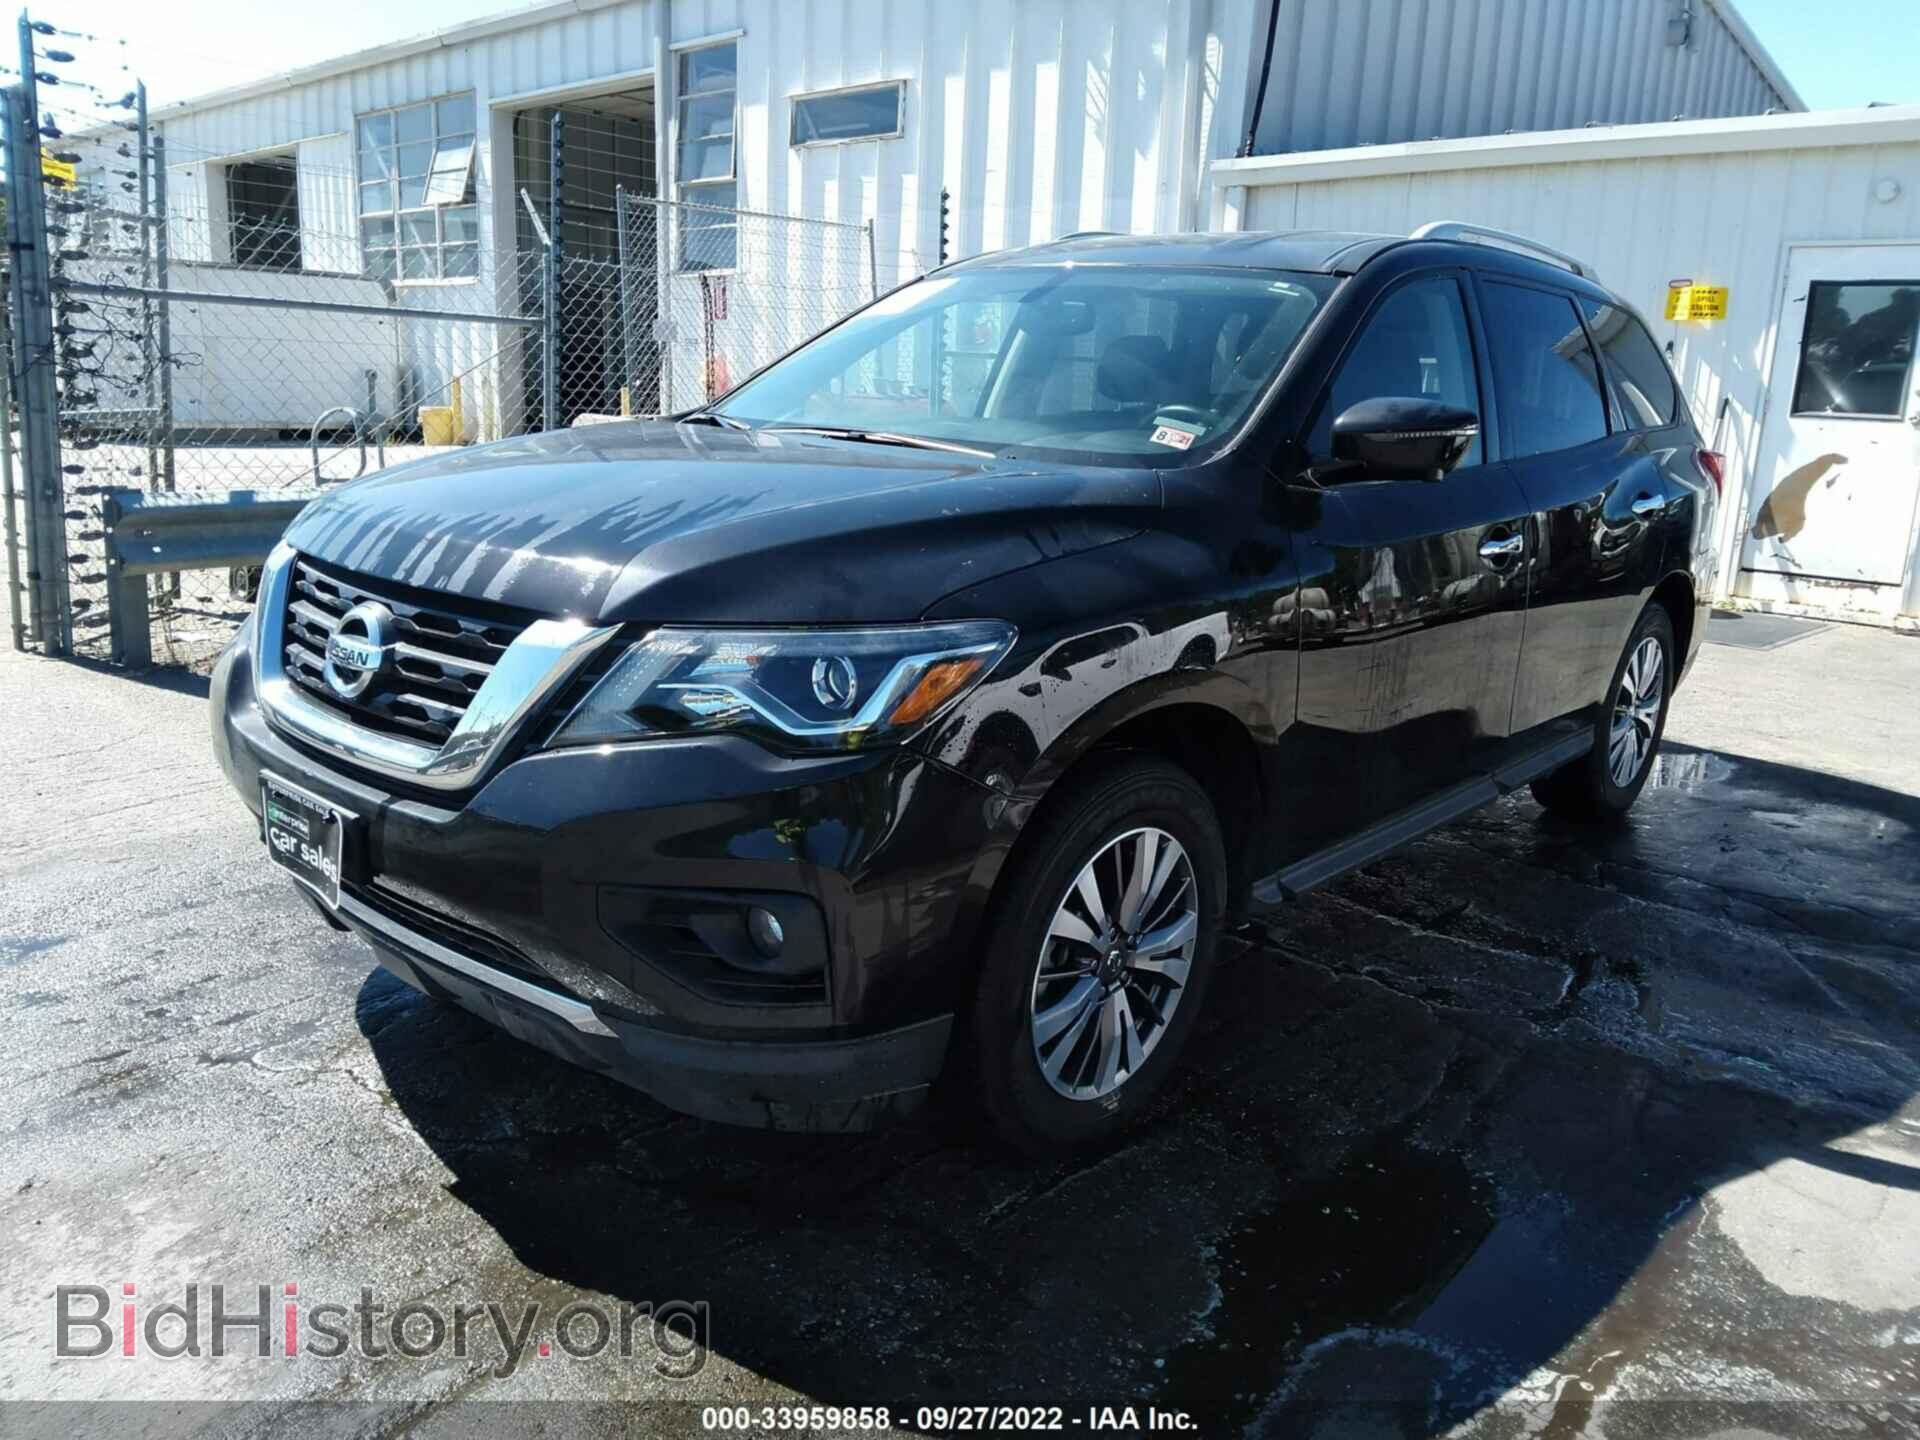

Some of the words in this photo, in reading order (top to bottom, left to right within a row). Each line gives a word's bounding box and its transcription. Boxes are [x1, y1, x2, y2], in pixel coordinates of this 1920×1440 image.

[1156, 431, 1168, 441] 8
[329, 643, 369, 666] SSAN
[270, 827, 298, 854] car
[301, 843, 337, 884] sales
